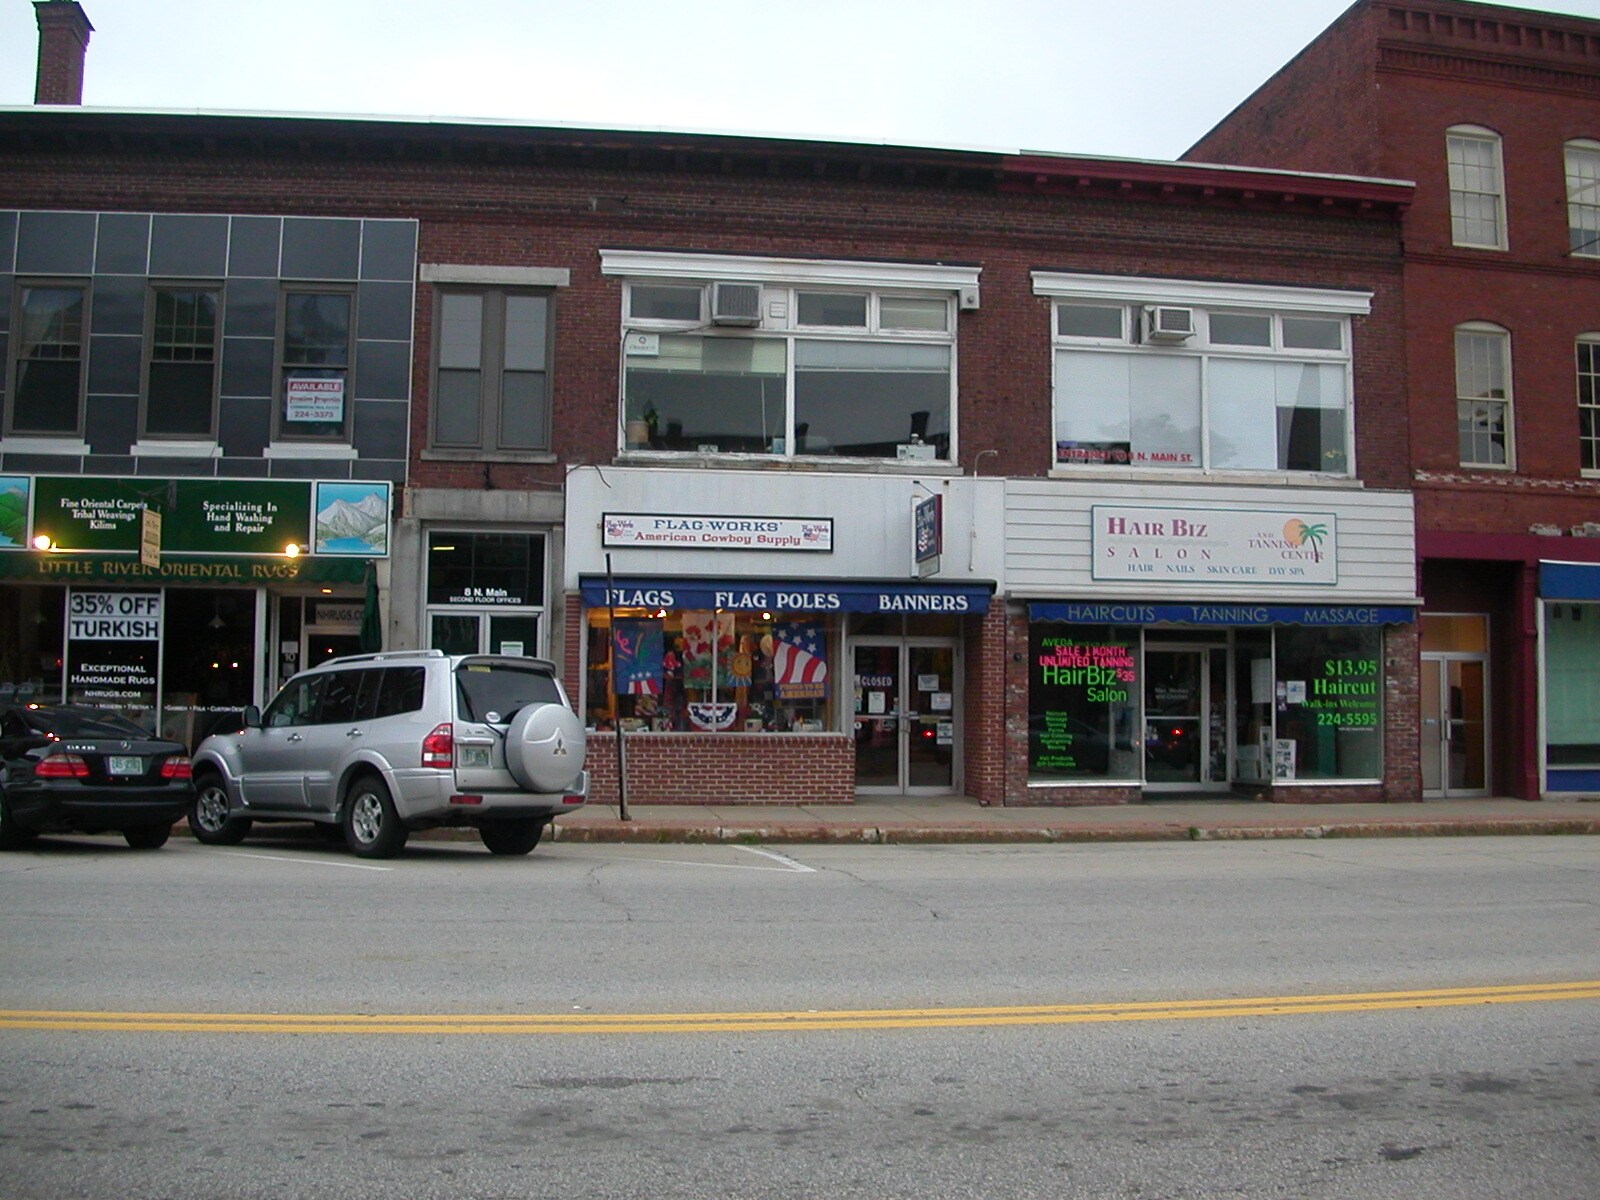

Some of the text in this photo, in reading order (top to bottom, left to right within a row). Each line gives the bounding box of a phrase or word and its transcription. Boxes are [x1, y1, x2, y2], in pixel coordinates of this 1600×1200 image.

[1138, 452, 1148, 460] N.
[1151, 453, 1177, 462] MAIN
[1180, 454, 1192, 462] ST.
[61, 498, 148, 510] Fine Oriental Carpets
[203, 501, 278, 513] Specializing In
[72, 509, 136, 521] Tribal Weavings
[207, 512, 273, 524] Hand Washing
[90, 520, 116, 529] Kilims
[214, 523, 265, 534] and Repair
[1108, 517, 1165, 536] HAIR
[635, 532, 696, 542] American
[702, 534, 751, 544] Cowboy
[757, 535, 801, 546] Supply
[1248, 539, 1298, 549] TANNING
[1281, 550, 1324, 560] CENTER
[40, 561, 298, 578] LITTLE RIVER ORIENTAL RUGS
[1128, 564, 1154, 572] HAIR
[1166, 564, 1195, 573] NAILS
[1268, 567, 1286, 575] DAY
[464, 588, 508, 597] 8 N. Main
[72, 594, 158, 614] 35% OFF
[606, 590, 968, 611] FLAGS FLAG POLES BANNERS
[317, 610, 364, 620] NHRUGS.CO
[1068, 606, 1378, 623] HAIRCUTS TANNING MASSAGE
[72, 620, 158, 637] TURKISH
[1055, 646, 1125, 657] SALE 1 MONTH
[1040, 656, 1134, 667] UNLIMITED TANNING
[1325, 660, 1377, 676] $13.95
[861, 676, 892, 686] CLOSED
[1314, 679, 1376, 694] Haircut
[85, 690, 141, 698] NHRUGS.COM
[1087, 687, 1126, 702] Salon
[1340, 700, 1376, 708] Welcome
[1318, 713, 1377, 725] 224-5595
